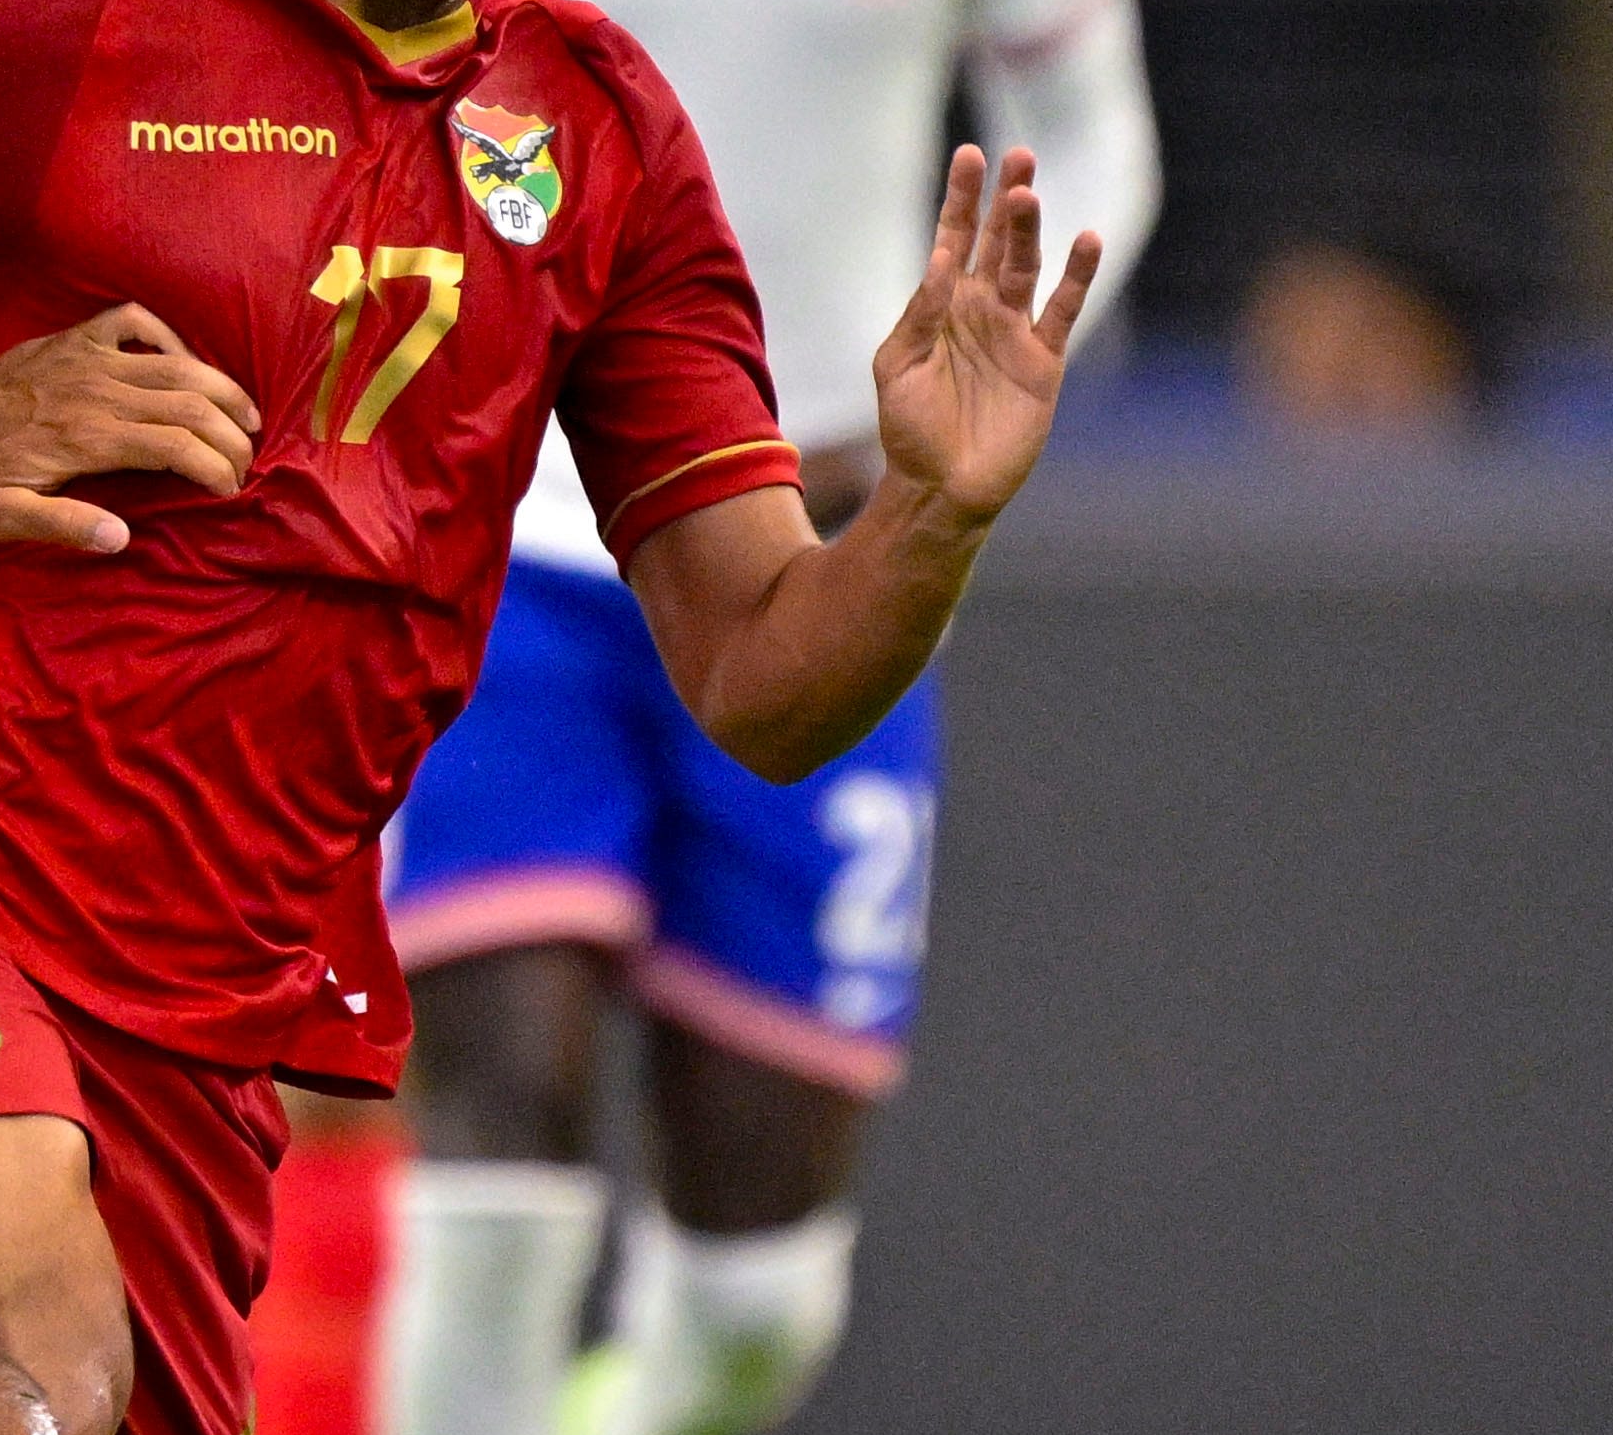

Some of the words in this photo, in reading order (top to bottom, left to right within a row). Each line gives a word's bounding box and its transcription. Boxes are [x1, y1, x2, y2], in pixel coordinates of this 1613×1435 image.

[130, 117, 338, 158] marathon
[499, 199, 533, 229] FBF
[310, 245, 465, 445] 17
[812, 770, 938, 959] 2
